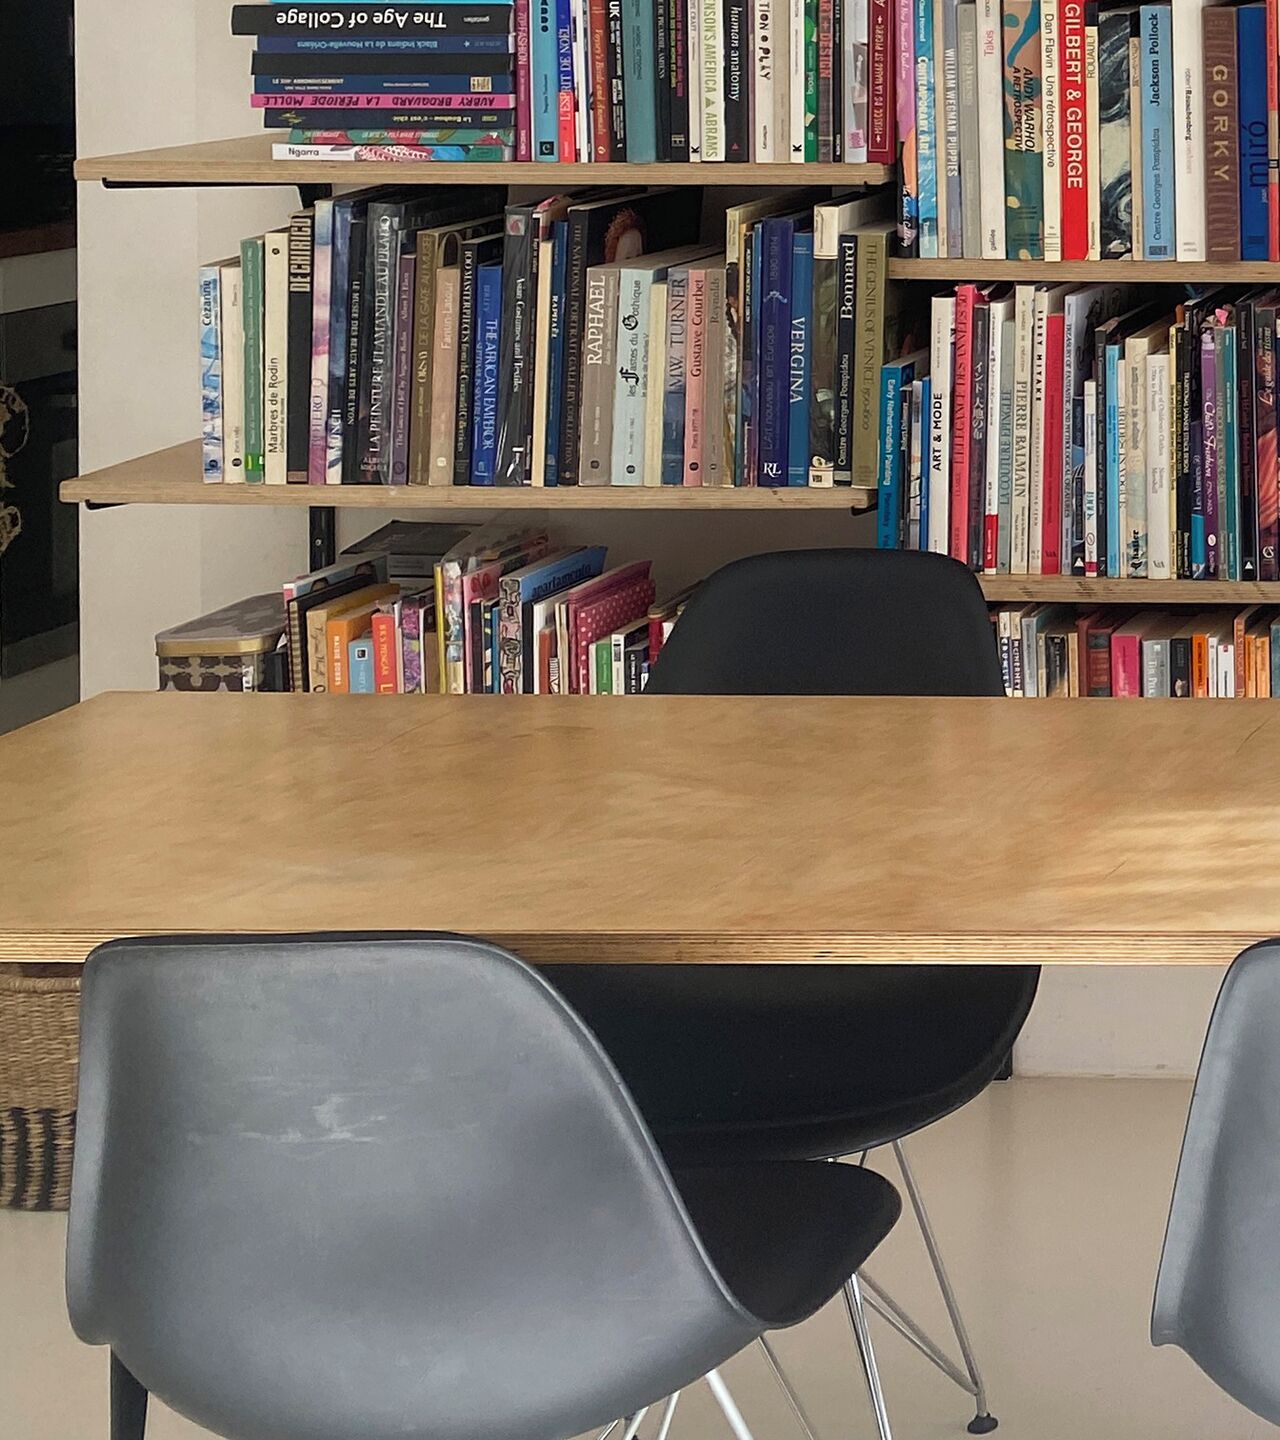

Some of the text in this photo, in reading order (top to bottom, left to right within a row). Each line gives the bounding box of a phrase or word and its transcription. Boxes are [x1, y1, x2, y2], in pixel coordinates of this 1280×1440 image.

[276, 8, 446, 29] The Age of Collage
[730, 6, 742, 101] human anatomy
[1150, 12, 1160, 106] Jackson Pollock
[706, 112, 718, 158] ABRAMS
[1065, 4, 1082, 188] GILBERT & GEORGE
[1212, 64, 1228, 183] GORKY
[288, 148, 320, 156] Ngarra
[588, 276, 606, 366] RAPHAEL
[670, 278, 686, 346] TURNER
[840, 242, 854, 319] Bonnard
[690, 280, 702, 378] Gustave Courbet
[790, 317, 805, 404] VERGINA
[933, 394, 942, 471] ART & MODE
[1016, 381, 1027, 496] PIERRE BALMAIN
